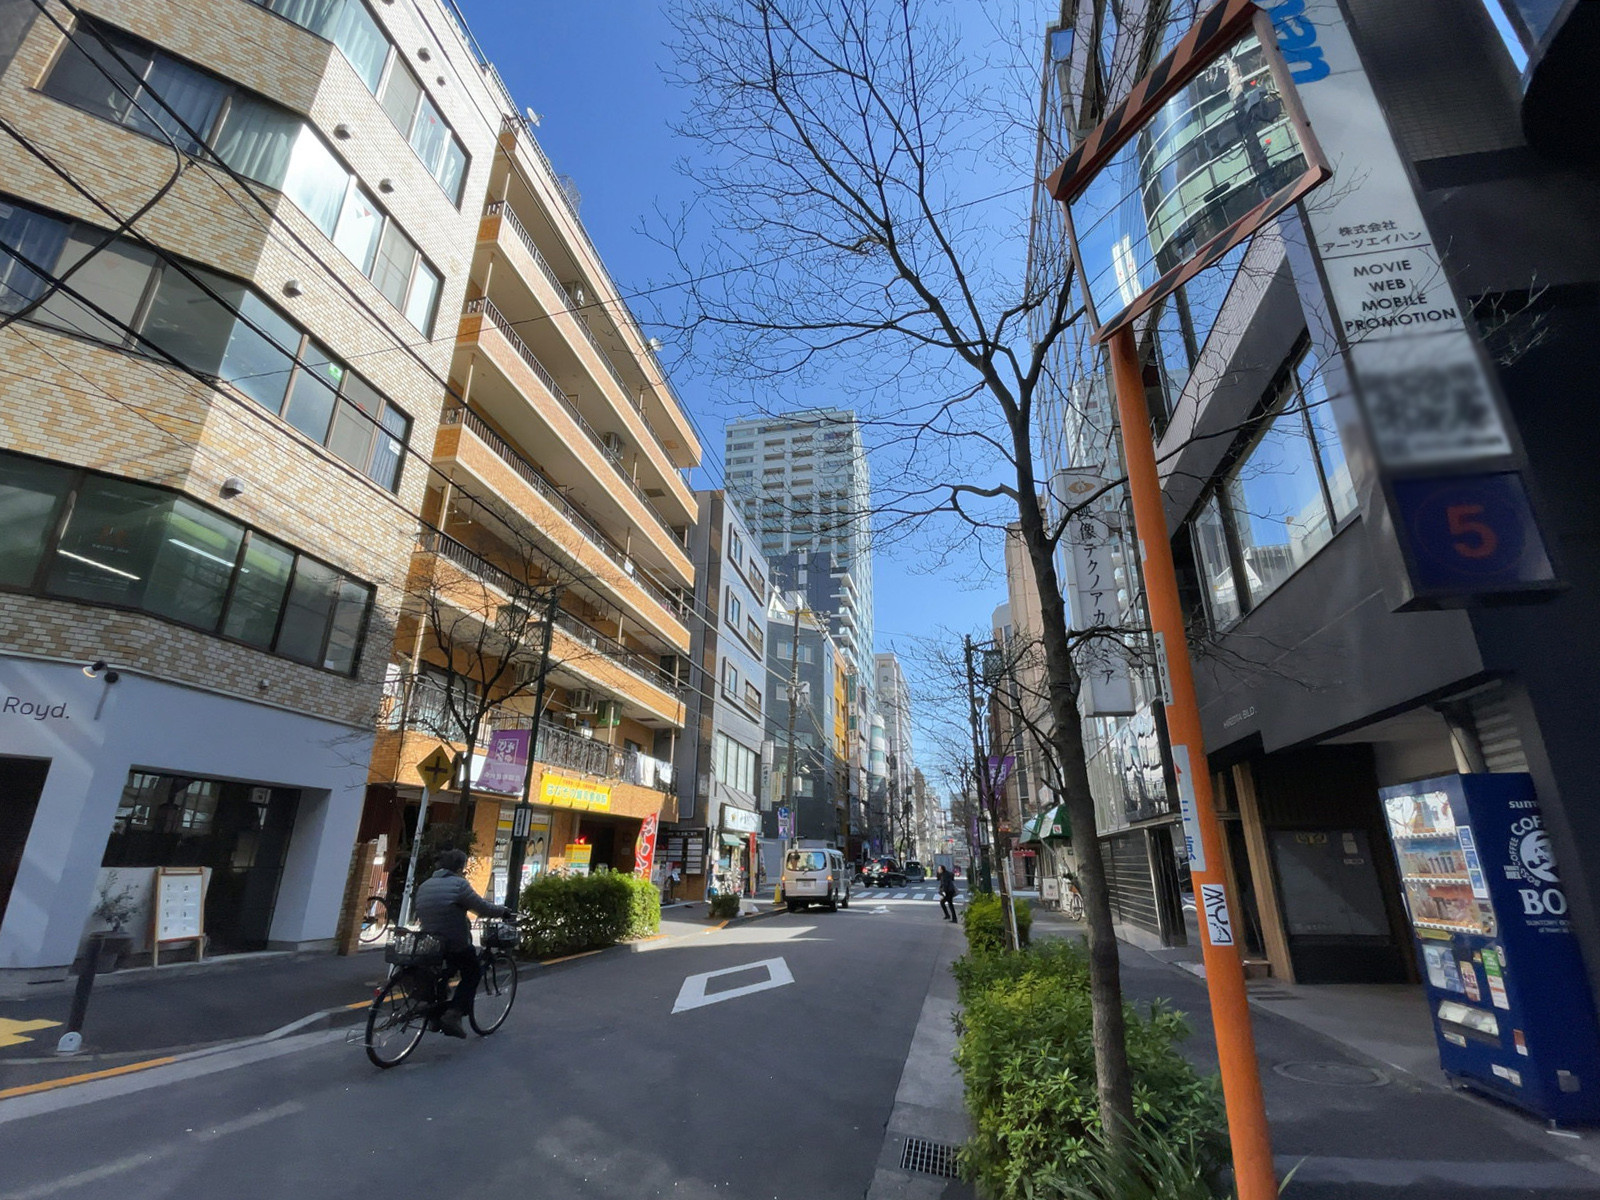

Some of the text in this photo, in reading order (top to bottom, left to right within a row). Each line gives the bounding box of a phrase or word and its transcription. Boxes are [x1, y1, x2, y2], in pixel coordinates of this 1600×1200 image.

[1338, 220, 1398, 237] 株式会社
[1323, 231, 1422, 253] アーツエイハン
[1353, 259, 1412, 277] MOVIE
[1368, 278, 1406, 293] WEB
[1362, 293, 1428, 312] MOBILE
[1344, 308, 1457, 332] PROMOTION
[1446, 504, 1499, 559] 5
[2, 696, 70, 721] Royd.
